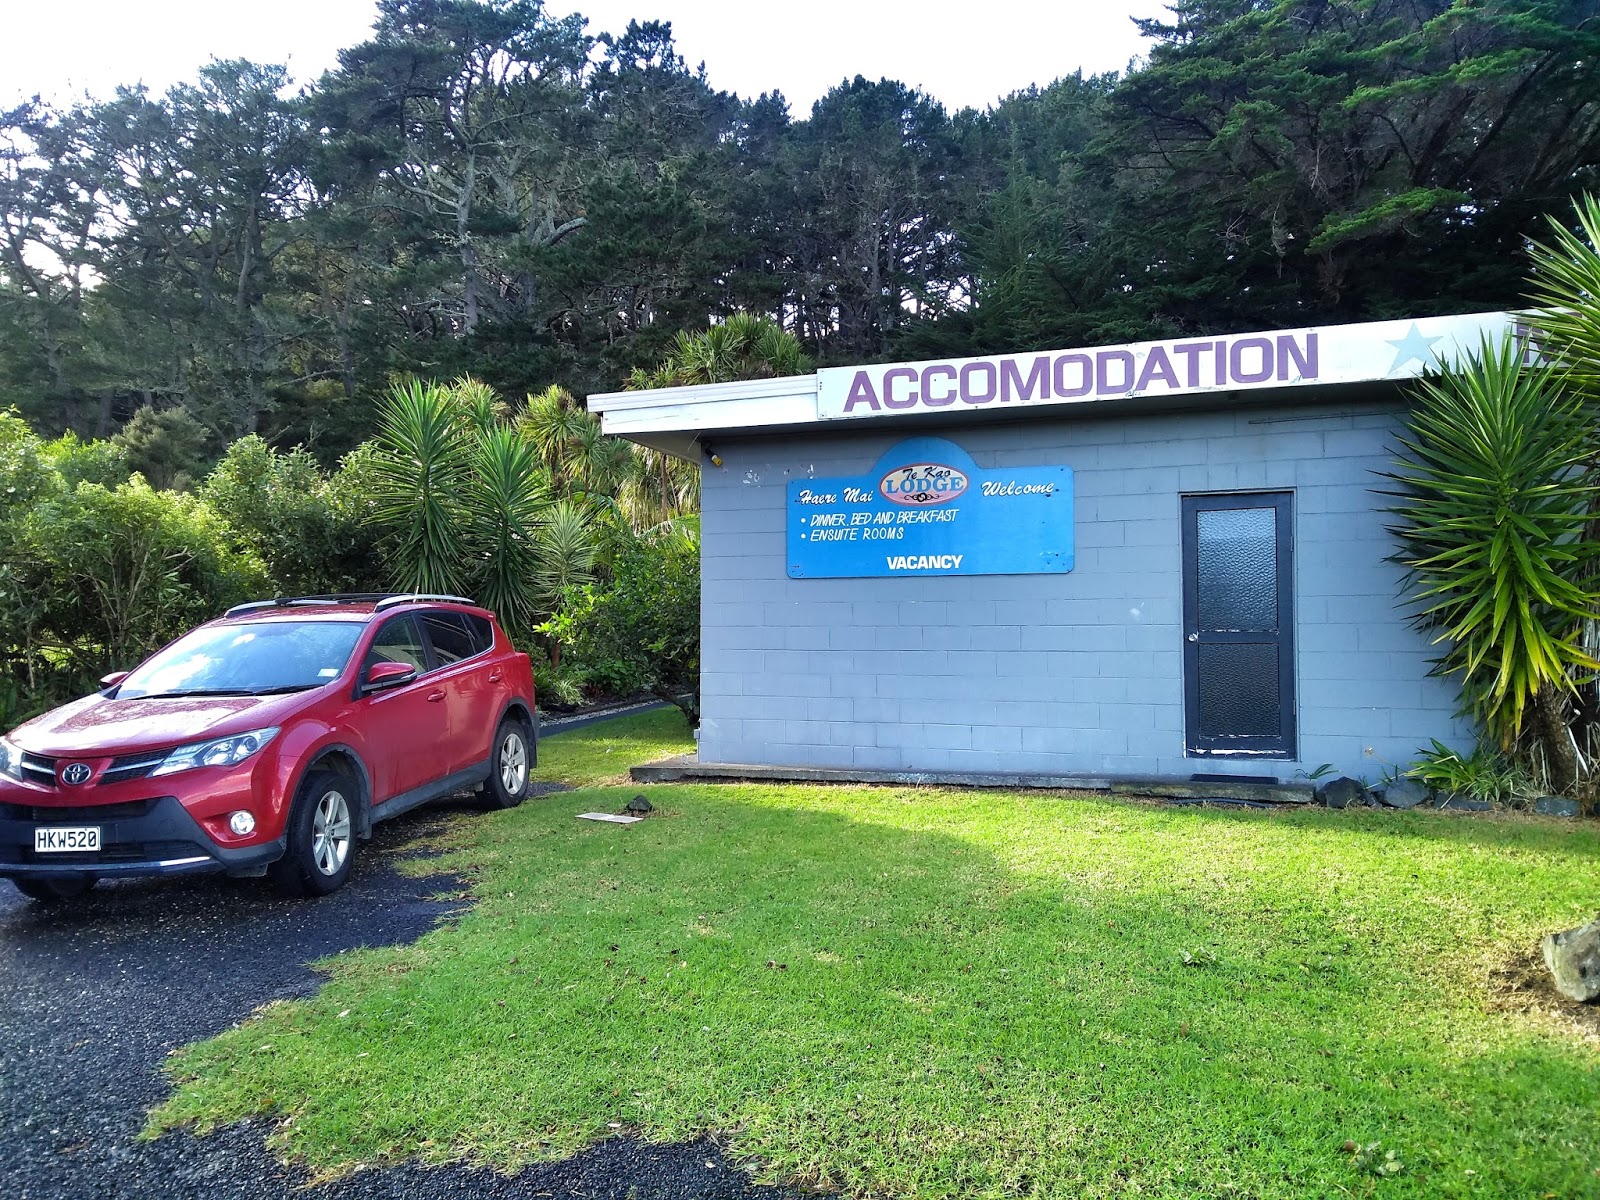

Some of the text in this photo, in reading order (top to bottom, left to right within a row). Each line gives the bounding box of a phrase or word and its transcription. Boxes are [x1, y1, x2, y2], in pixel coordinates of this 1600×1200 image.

[843, 332, 1319, 413] ACCOMODATION
[902, 466, 951, 480] Te Kao
[886, 476, 964, 494] LODGE
[981, 480, 1054, 497] Welcome
[799, 487, 873, 505] Haere Mai
[850, 512, 872, 525] BED
[873, 511, 895, 524] AND
[896, 509, 959, 523] BREAKFAST
[810, 527, 904, 542] ENSUITE ROOMS
[886, 555, 964, 570] VACANCY
[37, 831, 97, 849] HKW520
